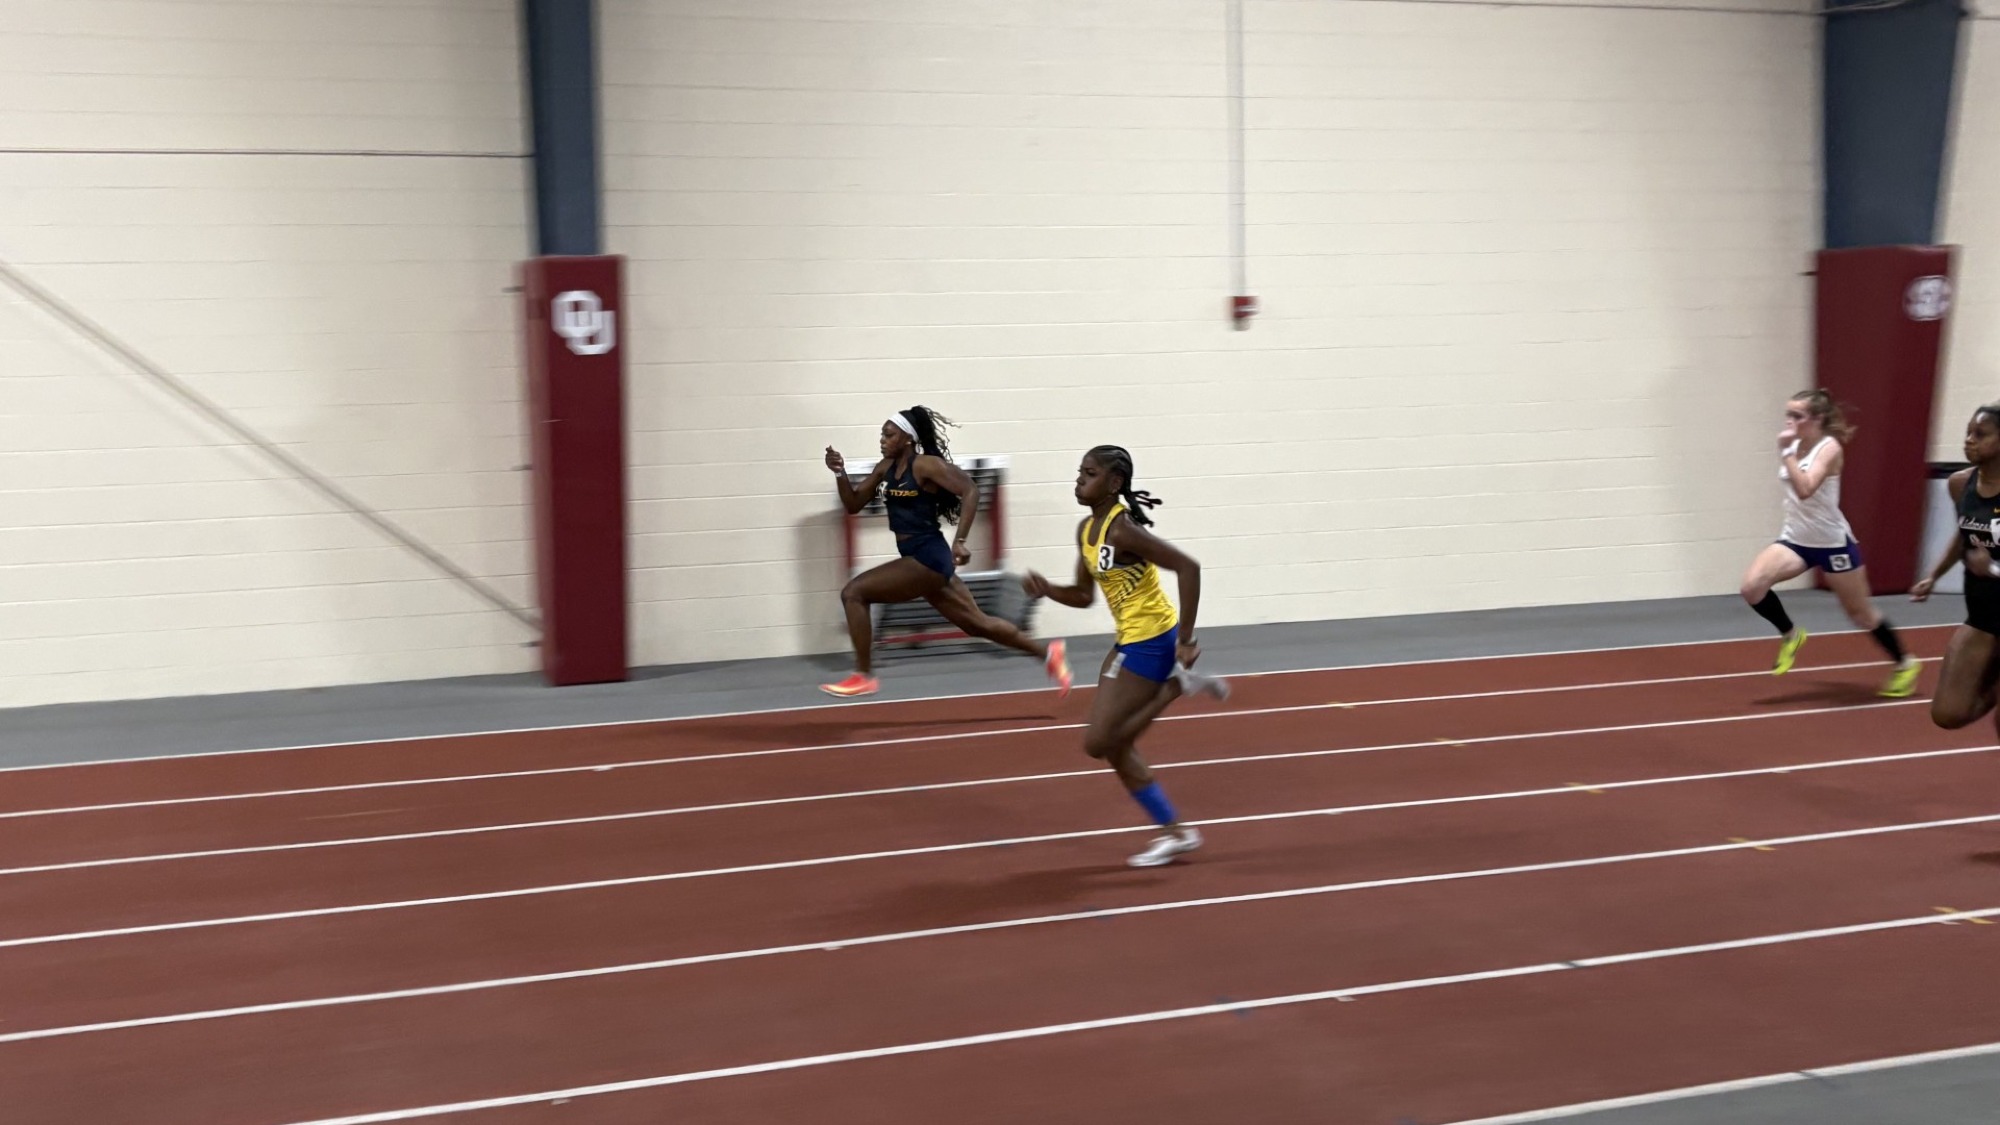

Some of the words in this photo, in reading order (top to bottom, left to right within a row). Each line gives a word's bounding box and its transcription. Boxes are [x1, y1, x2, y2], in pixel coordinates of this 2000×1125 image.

[551, 290, 616, 355] OU
[889, 488, 919, 497] TEXAS
[1099, 546, 1111, 571] 3
